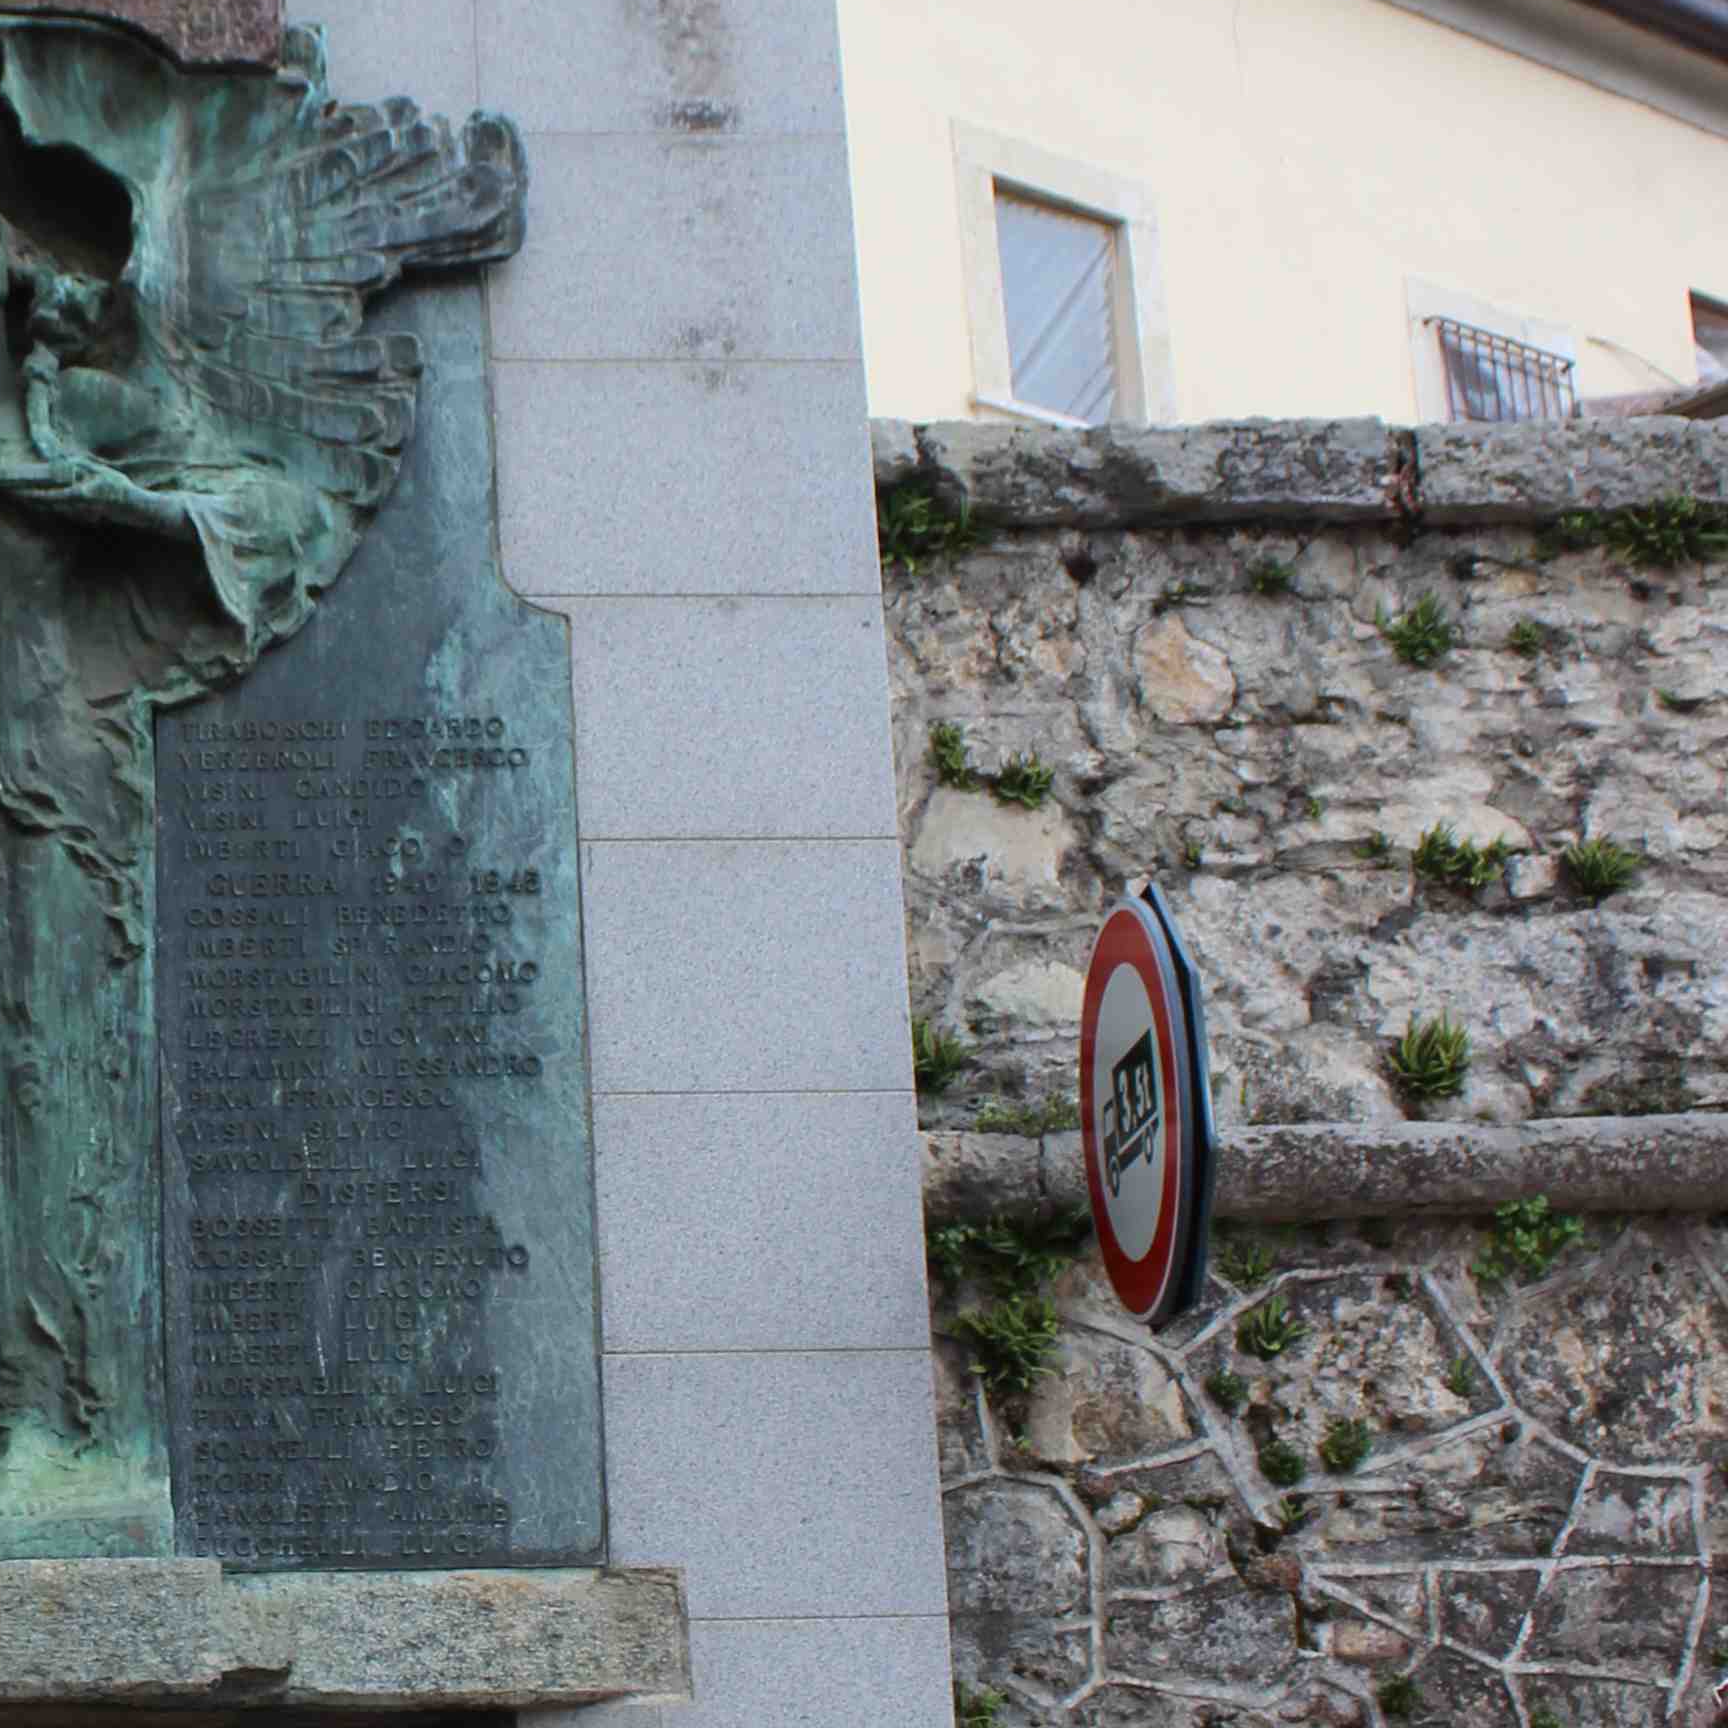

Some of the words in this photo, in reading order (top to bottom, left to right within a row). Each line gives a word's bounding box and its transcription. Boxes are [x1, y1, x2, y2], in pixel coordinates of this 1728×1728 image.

[207, 873, 339, 896] GUERRA
[285, 1086, 457, 1108] FRANCESCO
[400, 1149, 481, 1171] LUIGI
[300, 1180, 461, 1207] DISPERSI
[350, 1244, 530, 1269] BENVENUTO
[420, 1374, 498, 1396] LUIGI
[381, 1438, 496, 1461] PIETRO
